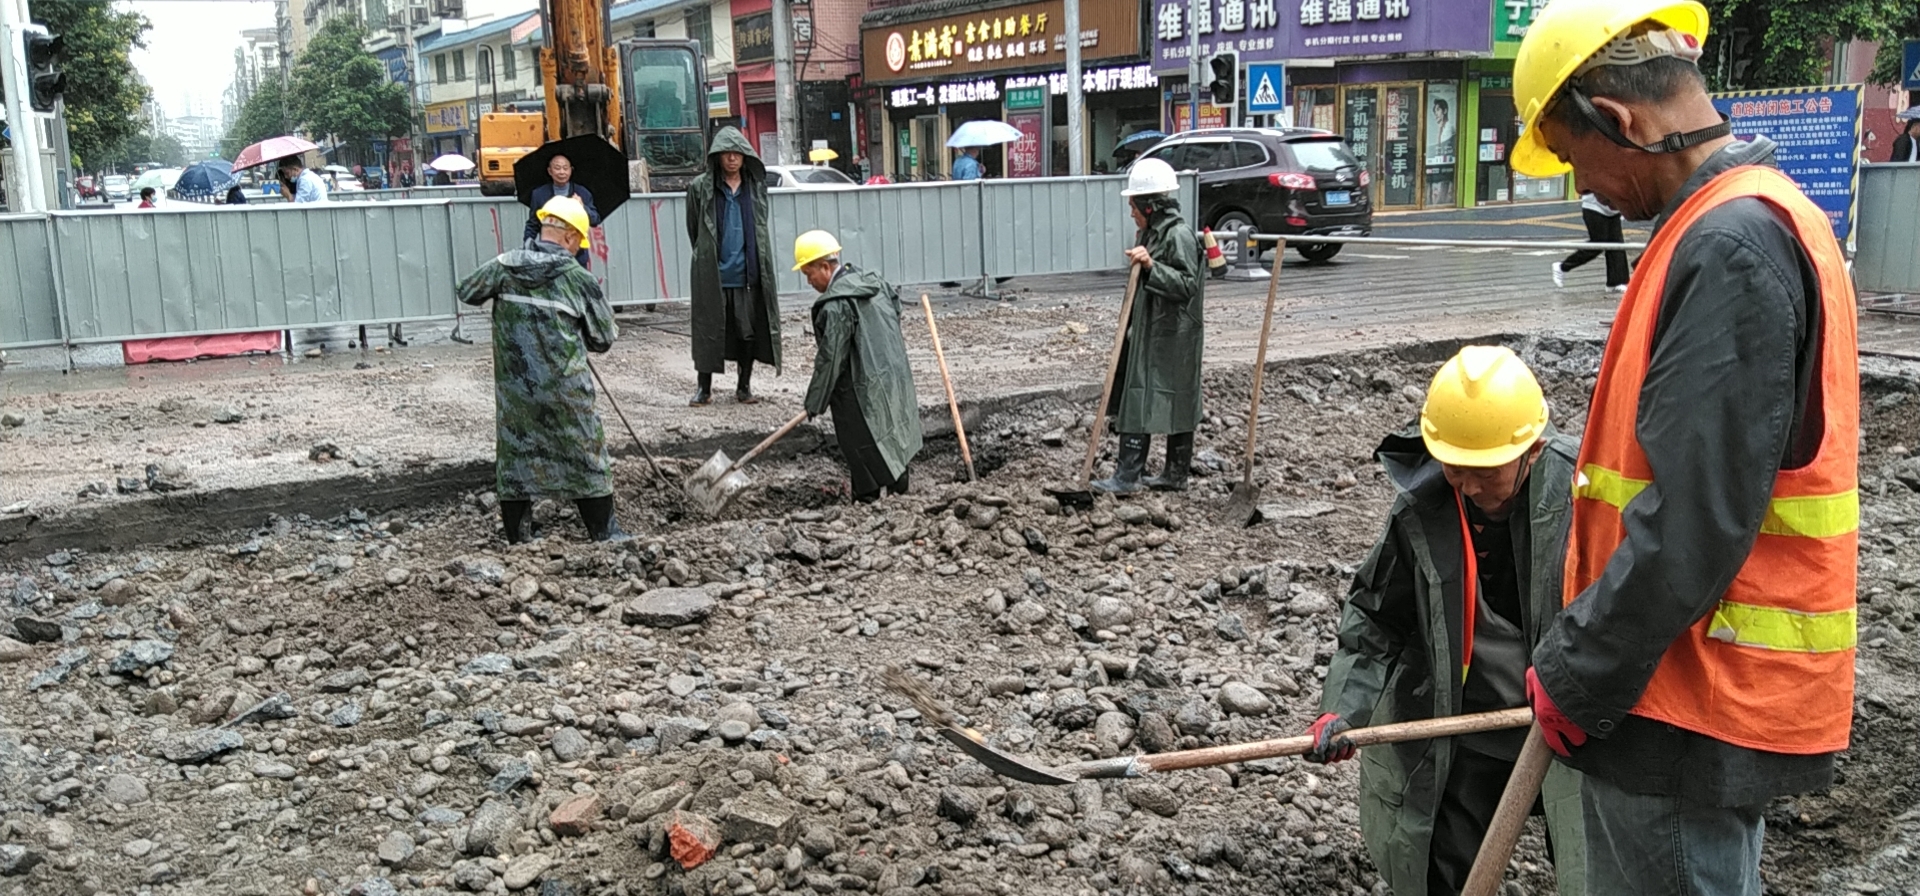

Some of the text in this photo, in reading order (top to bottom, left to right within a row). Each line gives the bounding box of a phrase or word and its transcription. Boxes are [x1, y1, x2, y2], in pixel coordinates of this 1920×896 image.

[1158, 0, 1277, 40] 维强通讯
[1300, 0, 1409, 25] 维强通讯
[965, 13, 1048, 44] 素食自助餐厅
[907, 24, 954, 62] 素满香
[1029, 40, 1047, 54] 环保
[1239, 37, 1275, 52] 专业维修
[1304, 36, 1350, 47] 手机分期付款
[1371, 32, 1403, 43] 专业维修
[1180, 105, 1222, 119] 高回收
[1731, 96, 1833, 118] 道路封闭施工公告
[1013, 152, 1037, 172] 整形
